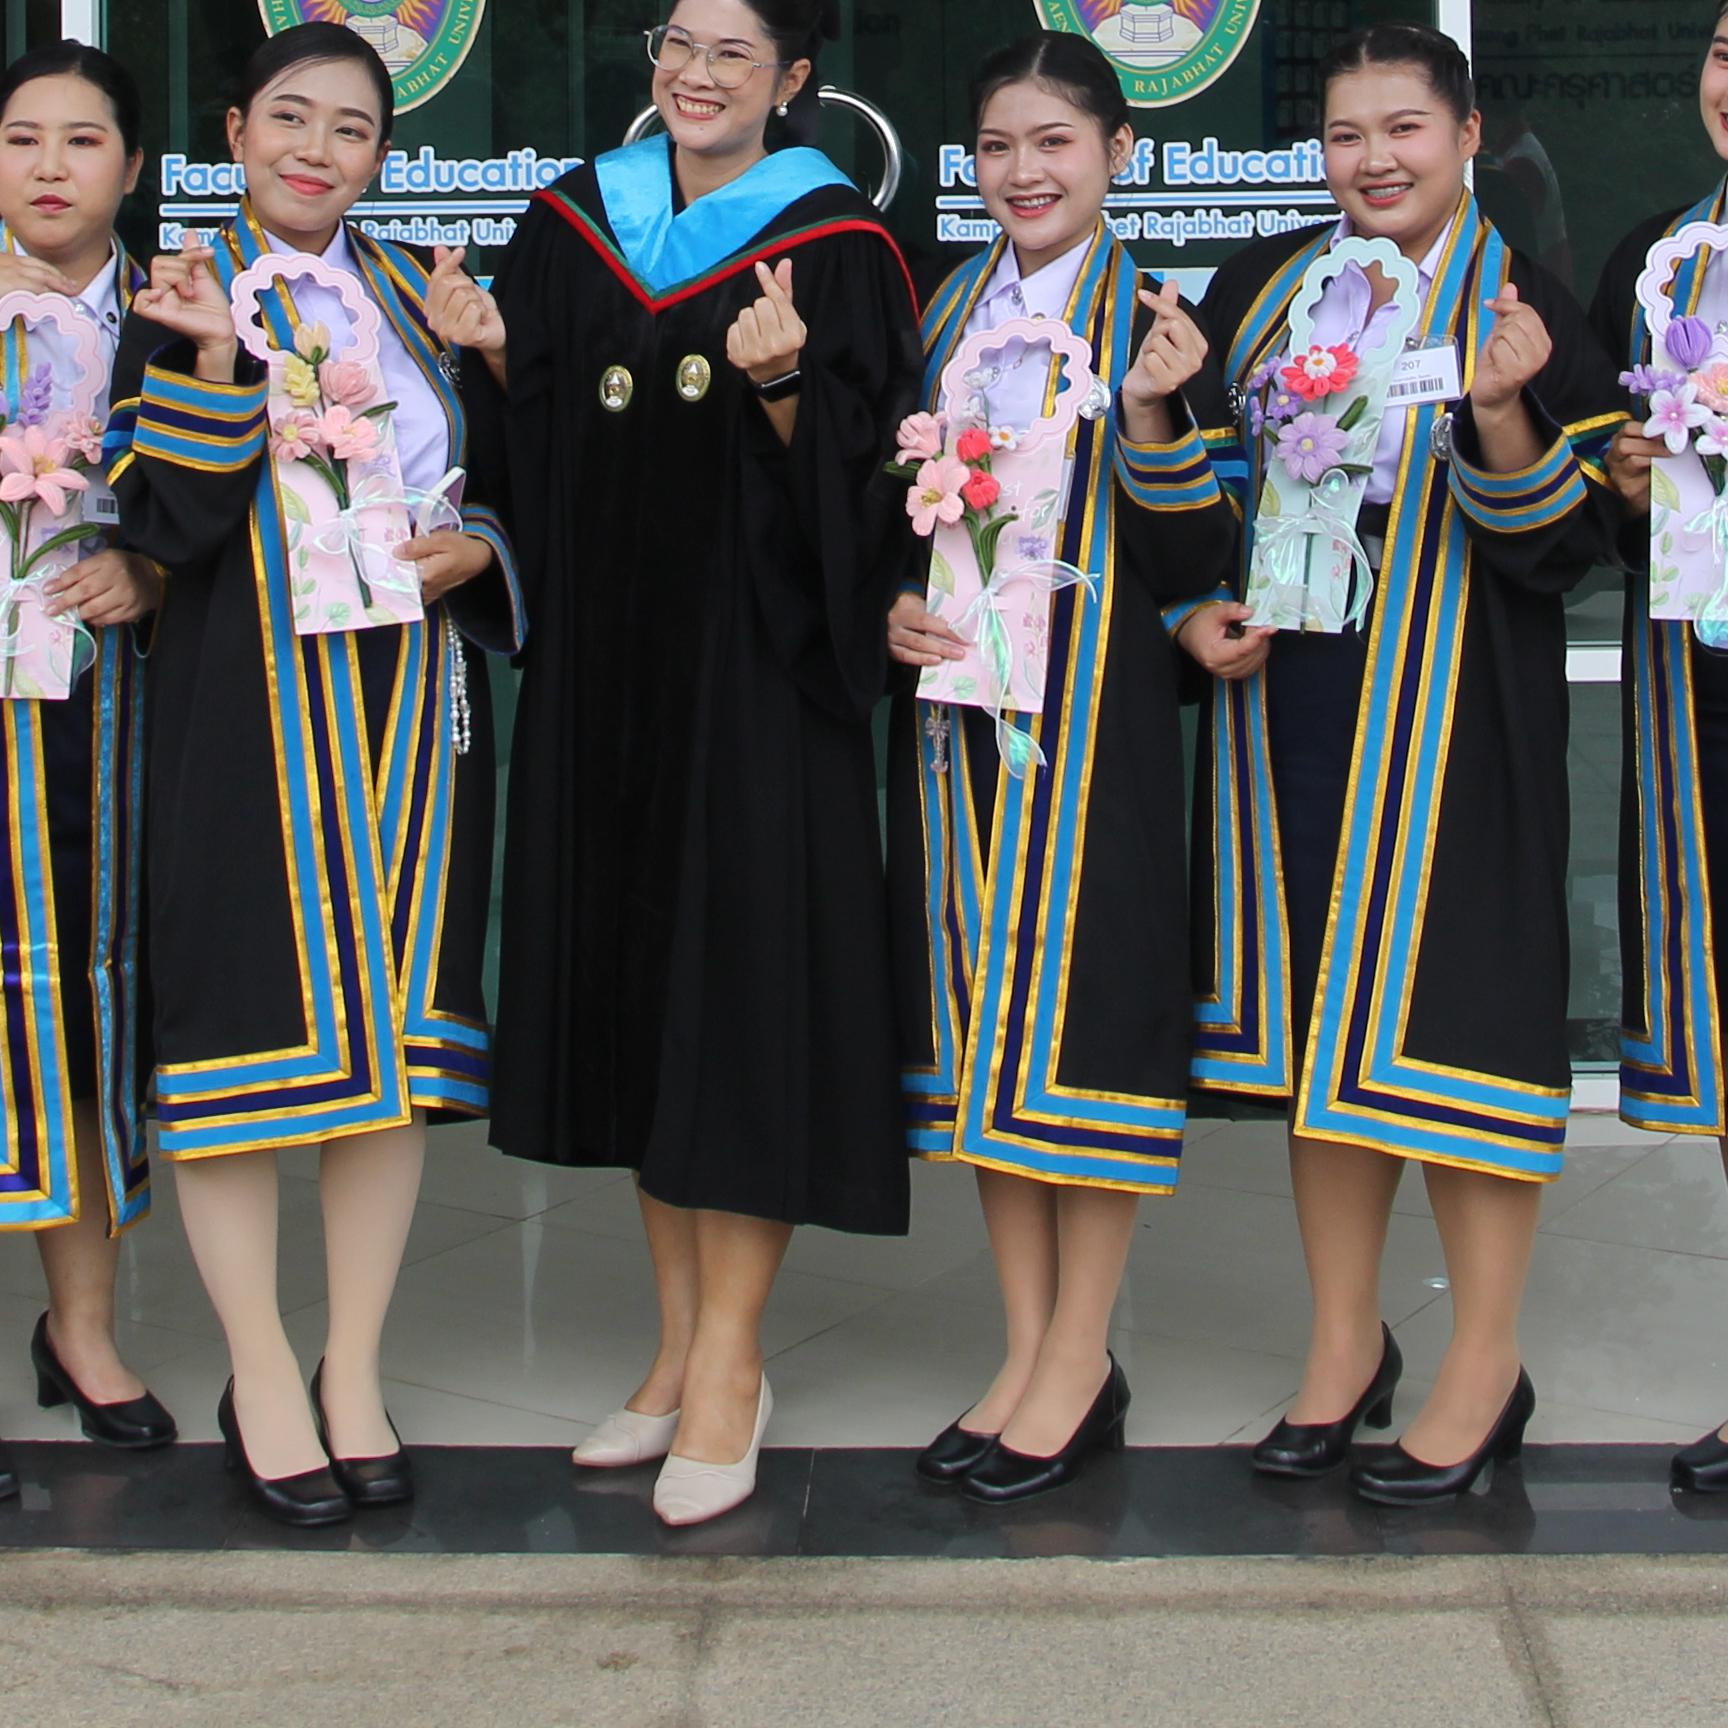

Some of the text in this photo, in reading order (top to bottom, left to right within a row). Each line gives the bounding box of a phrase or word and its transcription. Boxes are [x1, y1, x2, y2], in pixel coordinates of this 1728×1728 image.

[397, 53, 448, 98] ABHAT
[1134, 43, 1224, 96] RAJABHAT
[161, 153, 248, 196] Facu
[1162, 134, 1329, 186] Educati
[1143, 207, 1254, 246] Rajabhat
